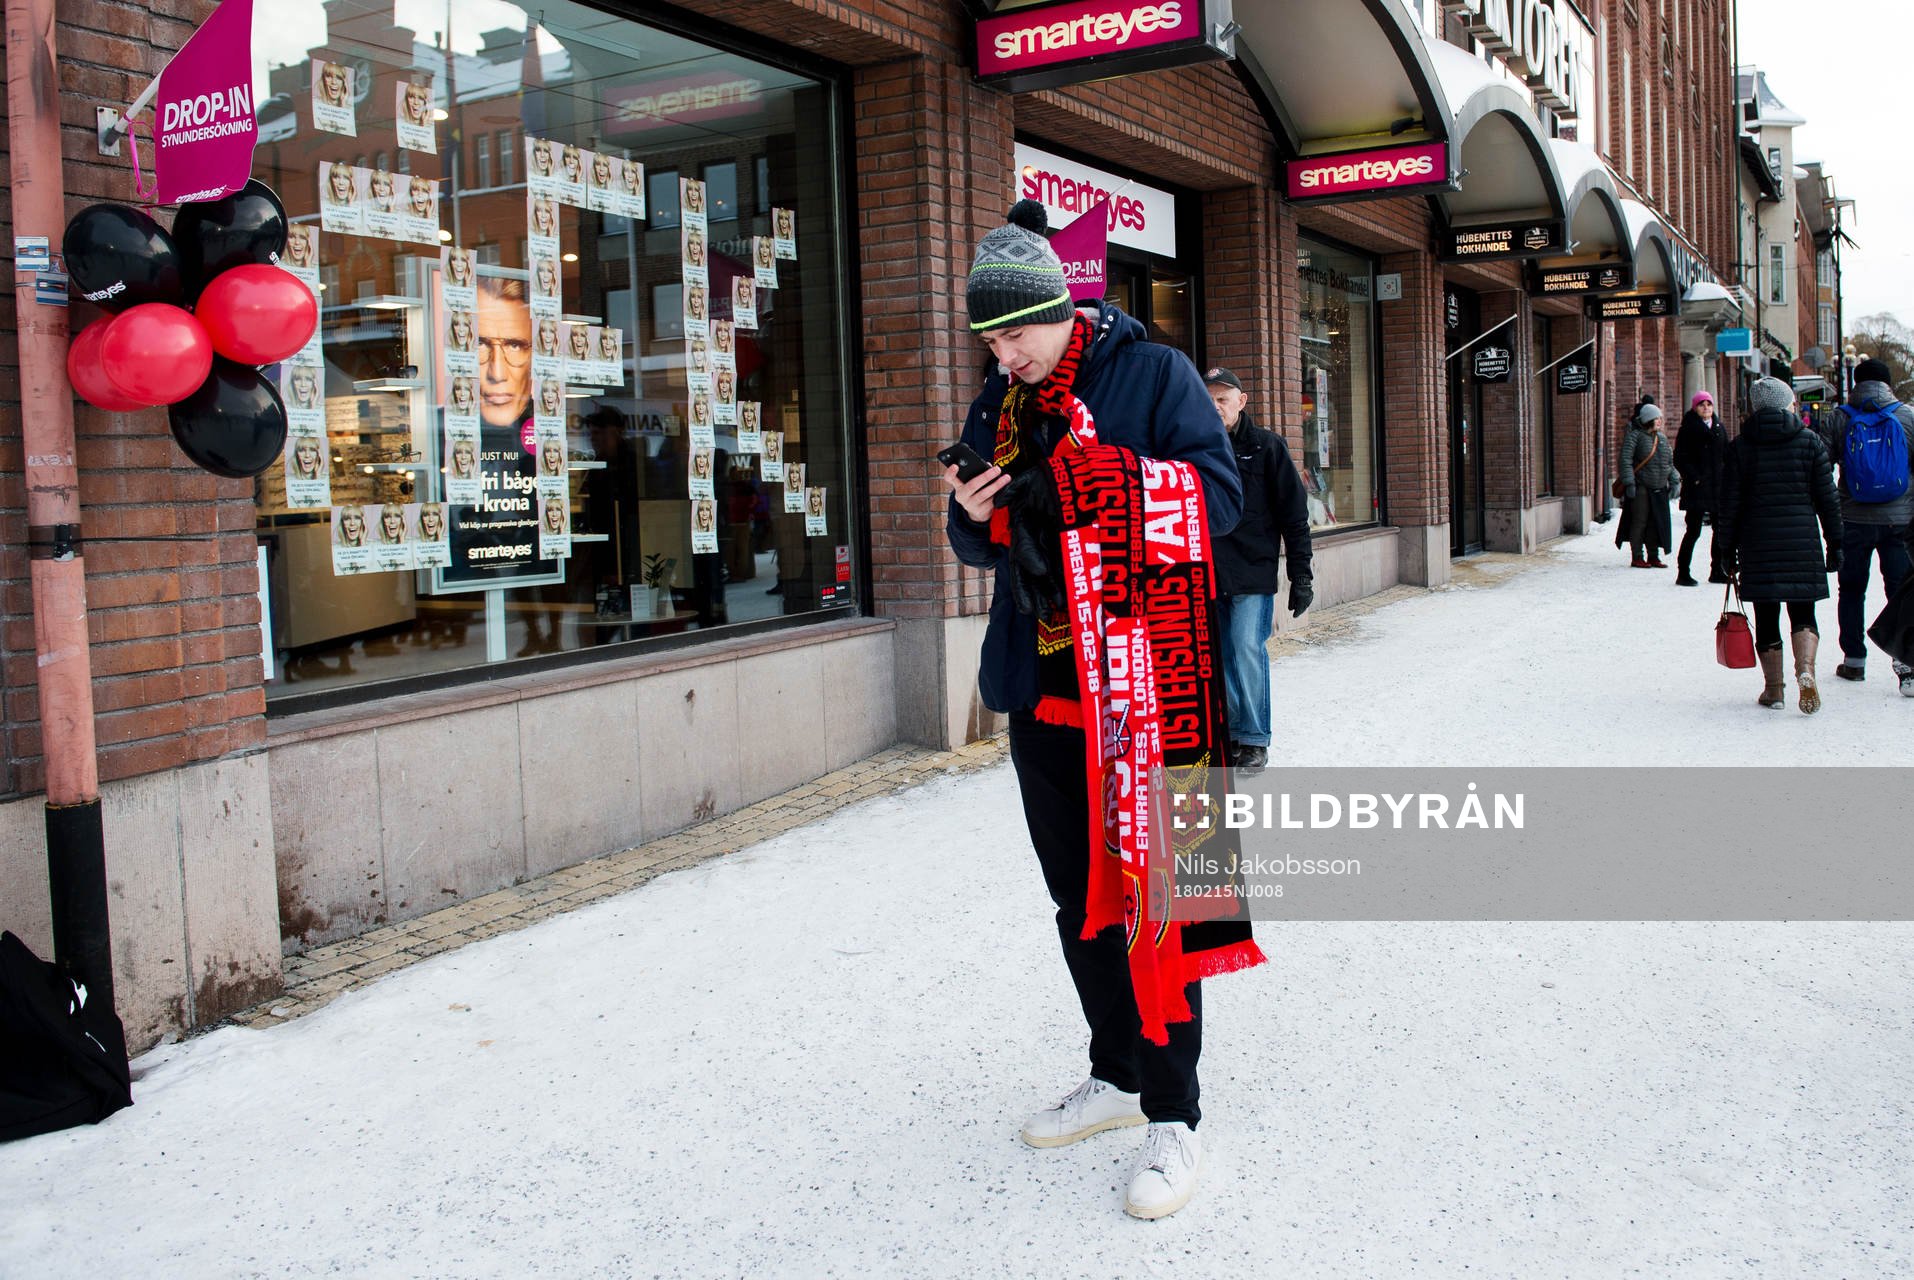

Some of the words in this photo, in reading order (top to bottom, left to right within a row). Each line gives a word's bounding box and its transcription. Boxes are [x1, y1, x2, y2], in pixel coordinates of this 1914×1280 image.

[994, 1, 1182, 59] smarteyes
[163, 83, 251, 132] DROP-IN
[161, 118, 253, 148] SYNUNDERSÖKNING
[1300, 155, 1433, 188] smarteyes
[1022, 165, 1146, 232] smarteyes
[1456, 230, 1513, 244] HÜBENETTES
[1456, 241, 1511, 255] BOKHANDEL
[1544, 281, 1589, 292] BOKHANDEL
[1602, 308, 1641, 317] BOKHANDEL
[524, 435, 537, 445] 25
[480, 451, 500, 461] JUST
[503, 451, 519, 460] NU!
[484, 493, 530, 513] krona
[459, 520, 469, 530] Vid
[1129, 474, 1144, 574] FEBRUARY
[1185, 493, 1203, 562] ARENA,
[468, 544, 533, 560] smarteyes
[1066, 530, 1089, 601] ARENA,
[1191, 566, 1213, 679] ÖSTERSUND
[1077, 600, 1100, 694] 15-02-18
